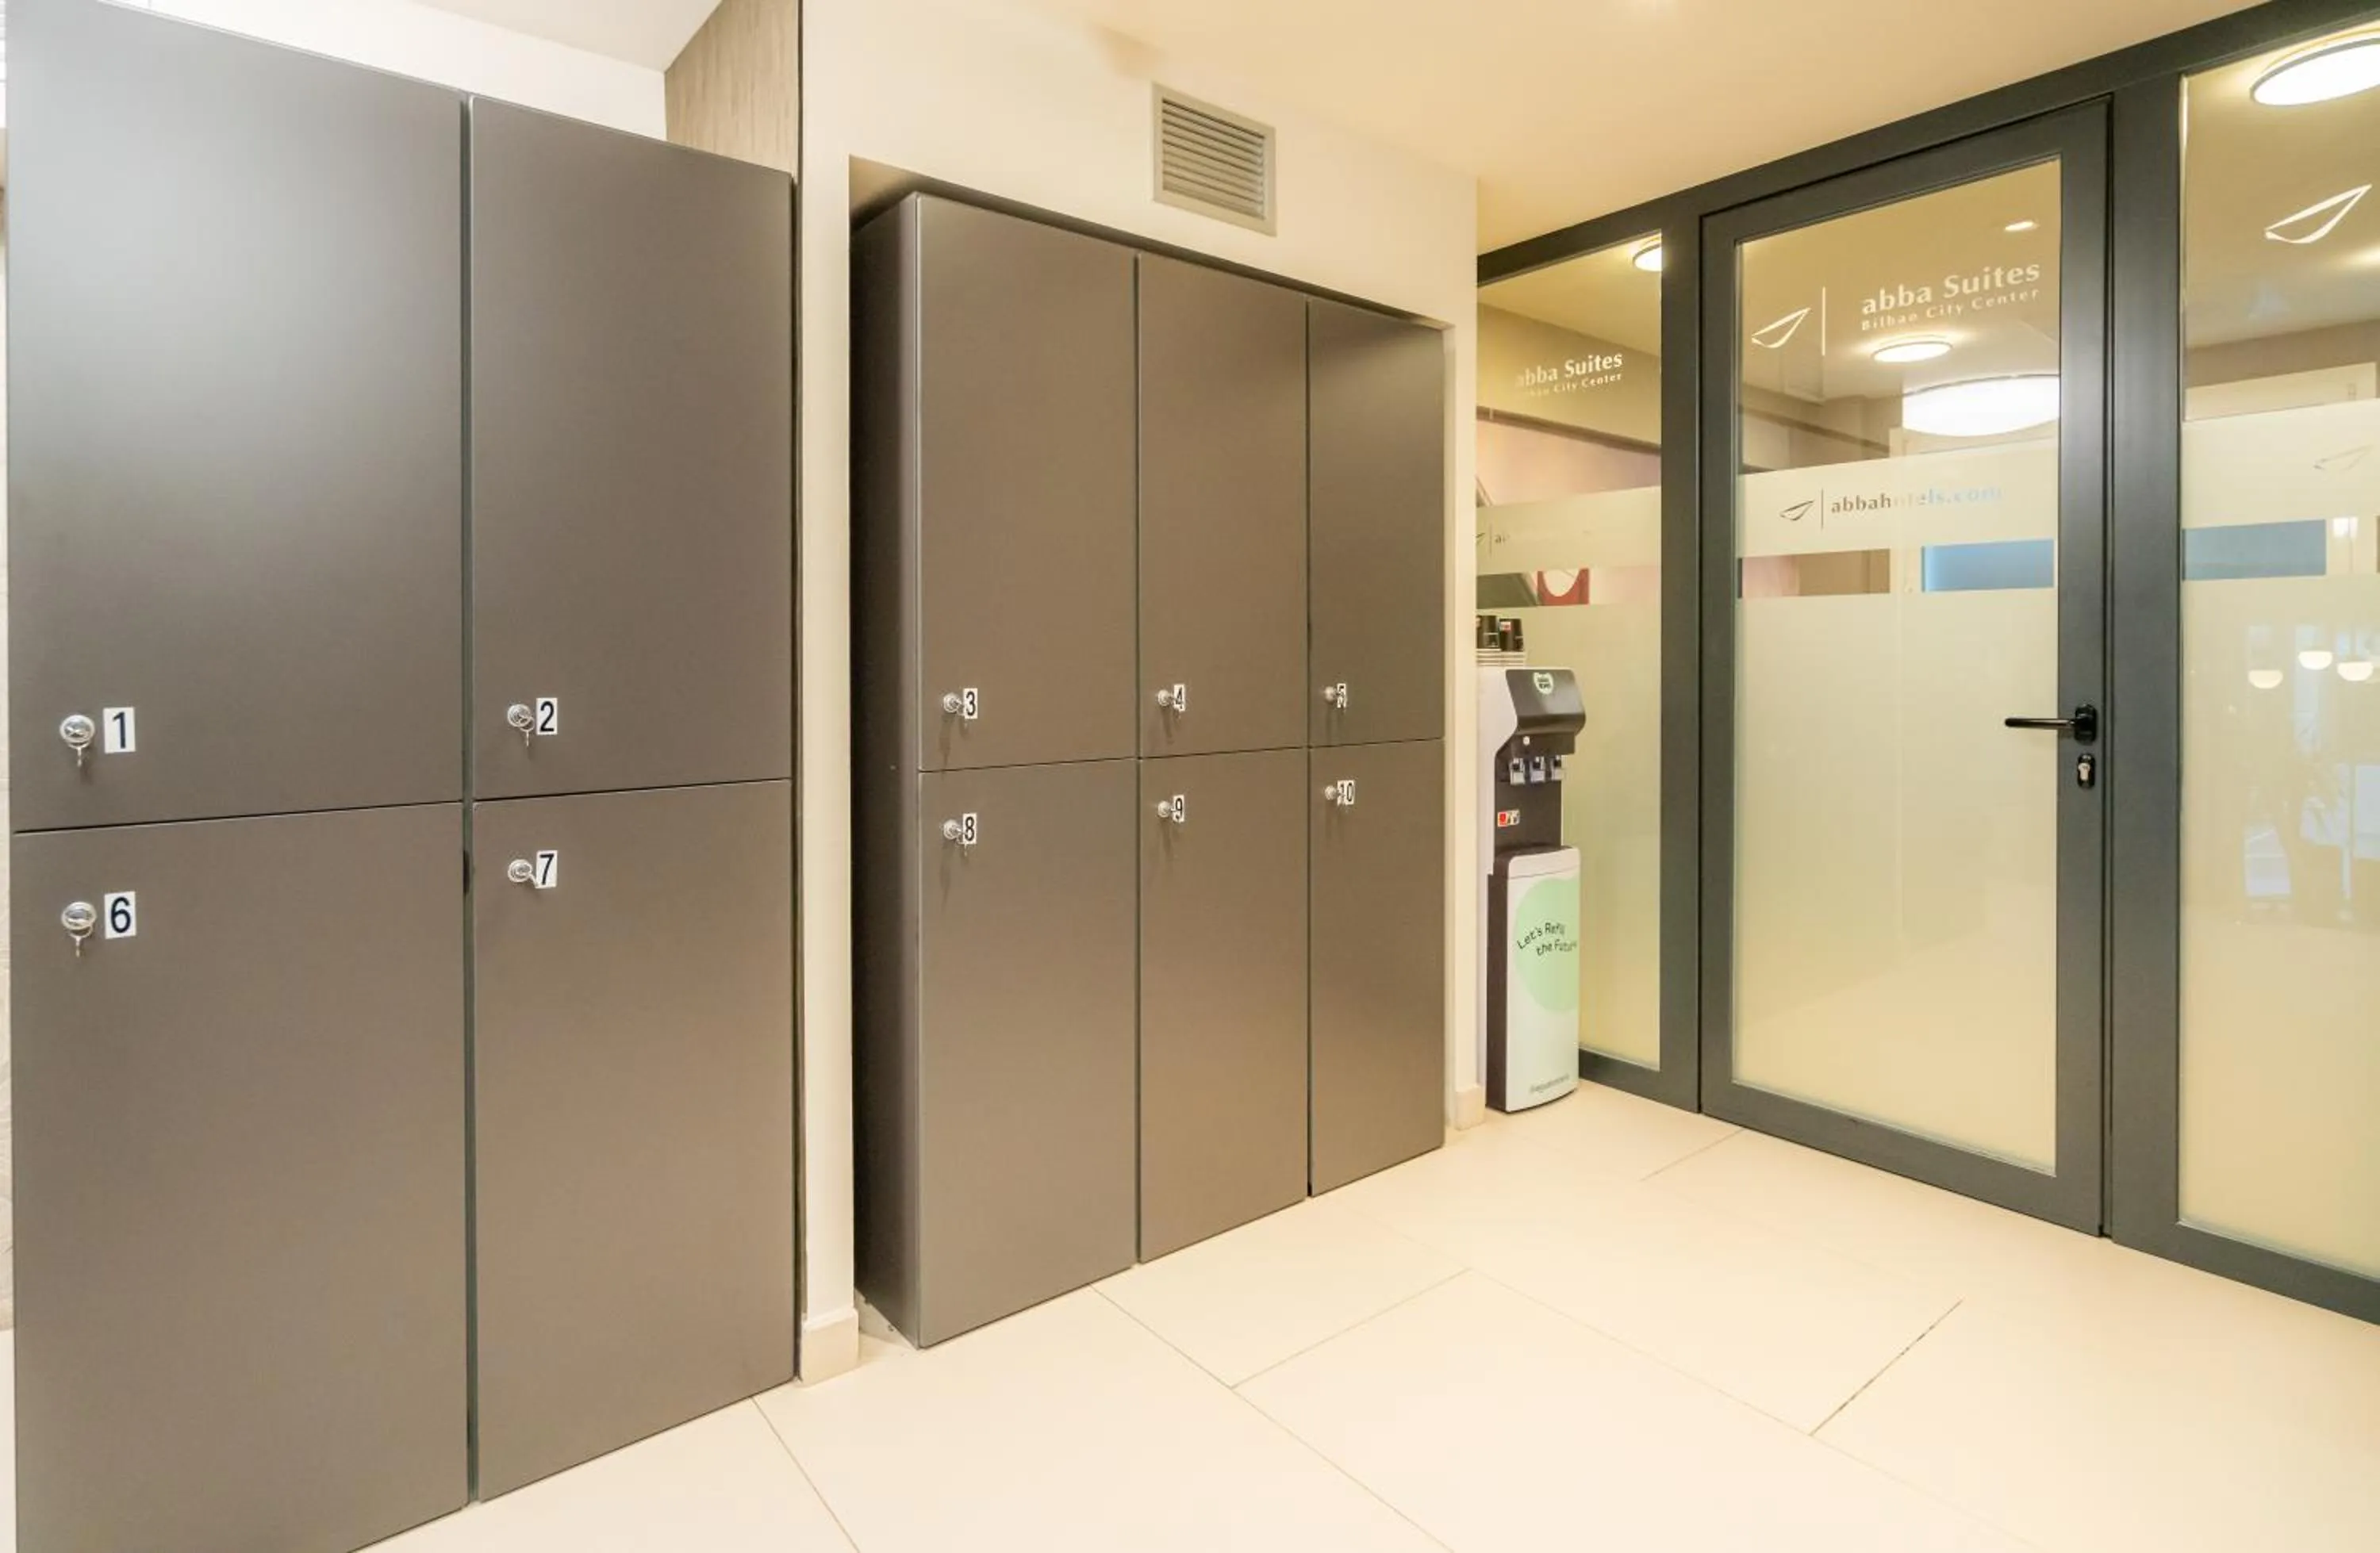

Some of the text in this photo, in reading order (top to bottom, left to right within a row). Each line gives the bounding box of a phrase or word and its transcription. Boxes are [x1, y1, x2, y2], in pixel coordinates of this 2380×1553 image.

[1861, 263, 2040, 315] abba Suites
[1861, 288, 2040, 331] Bilbao City Center
[1515, 353, 1623, 387] abba Suites
[965, 691, 976, 716] 3
[1175, 687, 1183, 710] 4
[112, 711, 126, 750] 1
[540, 700, 555, 732] 2
[1175, 797, 1183, 819] 9
[1339, 782, 1354, 802] 10
[965, 817, 975, 842] 8
[539, 853, 555, 886] 7
[110, 896, 131, 934] 6
[1516, 926, 1543, 949] Let's
